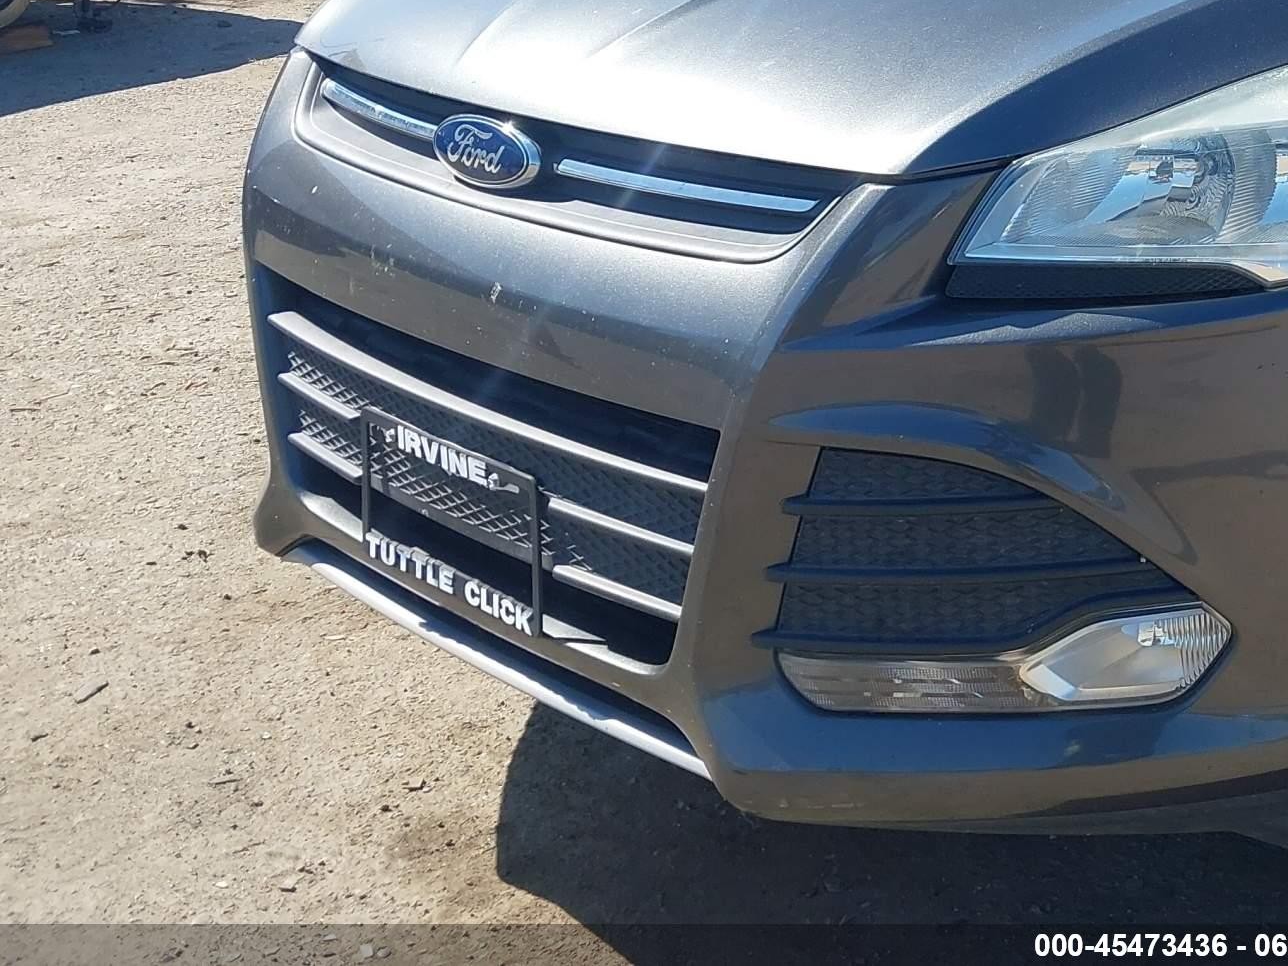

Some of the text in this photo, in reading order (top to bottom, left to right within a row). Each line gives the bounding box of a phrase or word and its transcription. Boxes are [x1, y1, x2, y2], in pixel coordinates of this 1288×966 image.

[446, 123, 506, 175] Ford
[397, 425, 488, 486] IRVINE
[366, 530, 534, 636] TUTTLE CLICK
